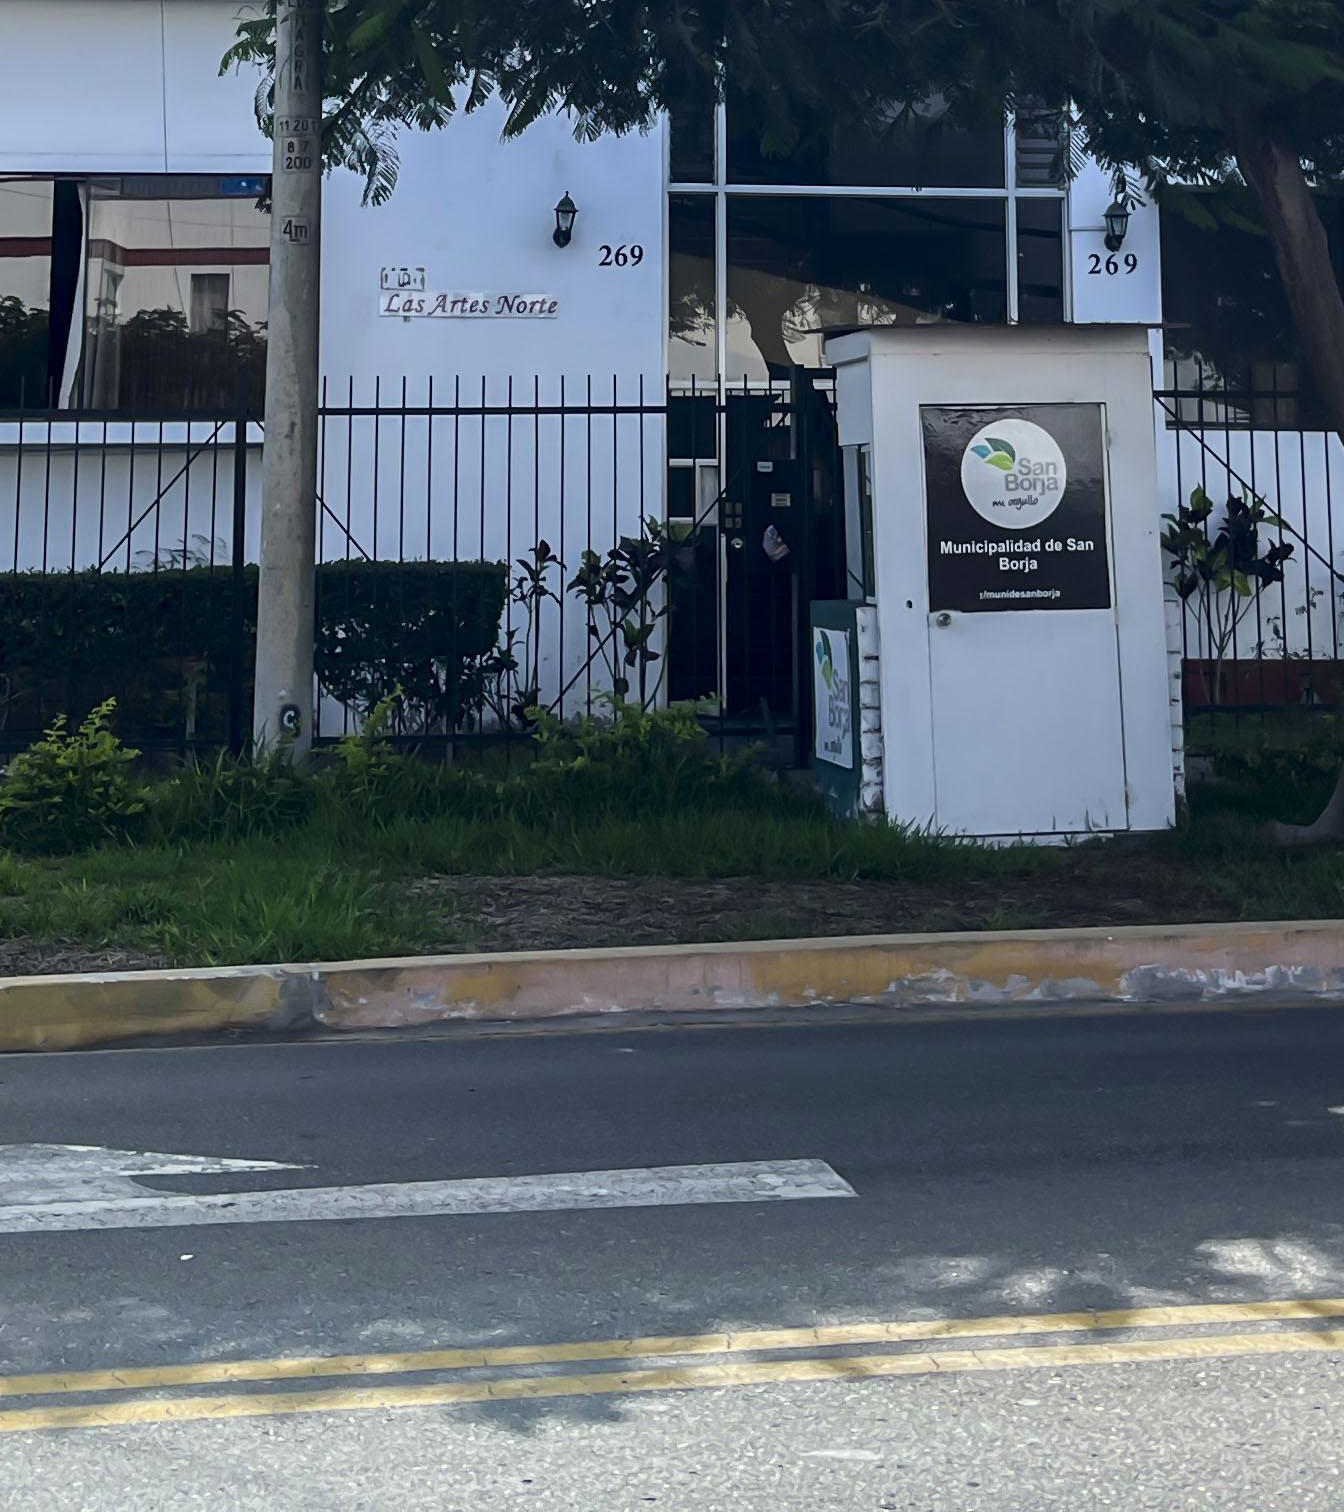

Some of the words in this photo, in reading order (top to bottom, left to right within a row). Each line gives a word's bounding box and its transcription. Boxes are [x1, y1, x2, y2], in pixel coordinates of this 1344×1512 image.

[286, 156, 312, 170] 200
[283, 219, 308, 242] 4m
[598, 244, 644, 267] 269
[1088, 253, 1138, 275] 269
[384, 293, 425, 313] Las
[428, 294, 490, 316] Artes
[495, 295, 558, 315] Norte
[1018, 457, 1057, 476] San
[1004, 473, 1058, 496] Borja
[1008, 494, 1039, 511] orgullo
[940, 539, 1041, 556] Municipalidad
[1045, 538, 1063, 552] de
[1066, 537, 1094, 552] San
[999, 556, 1038, 573] Borja
